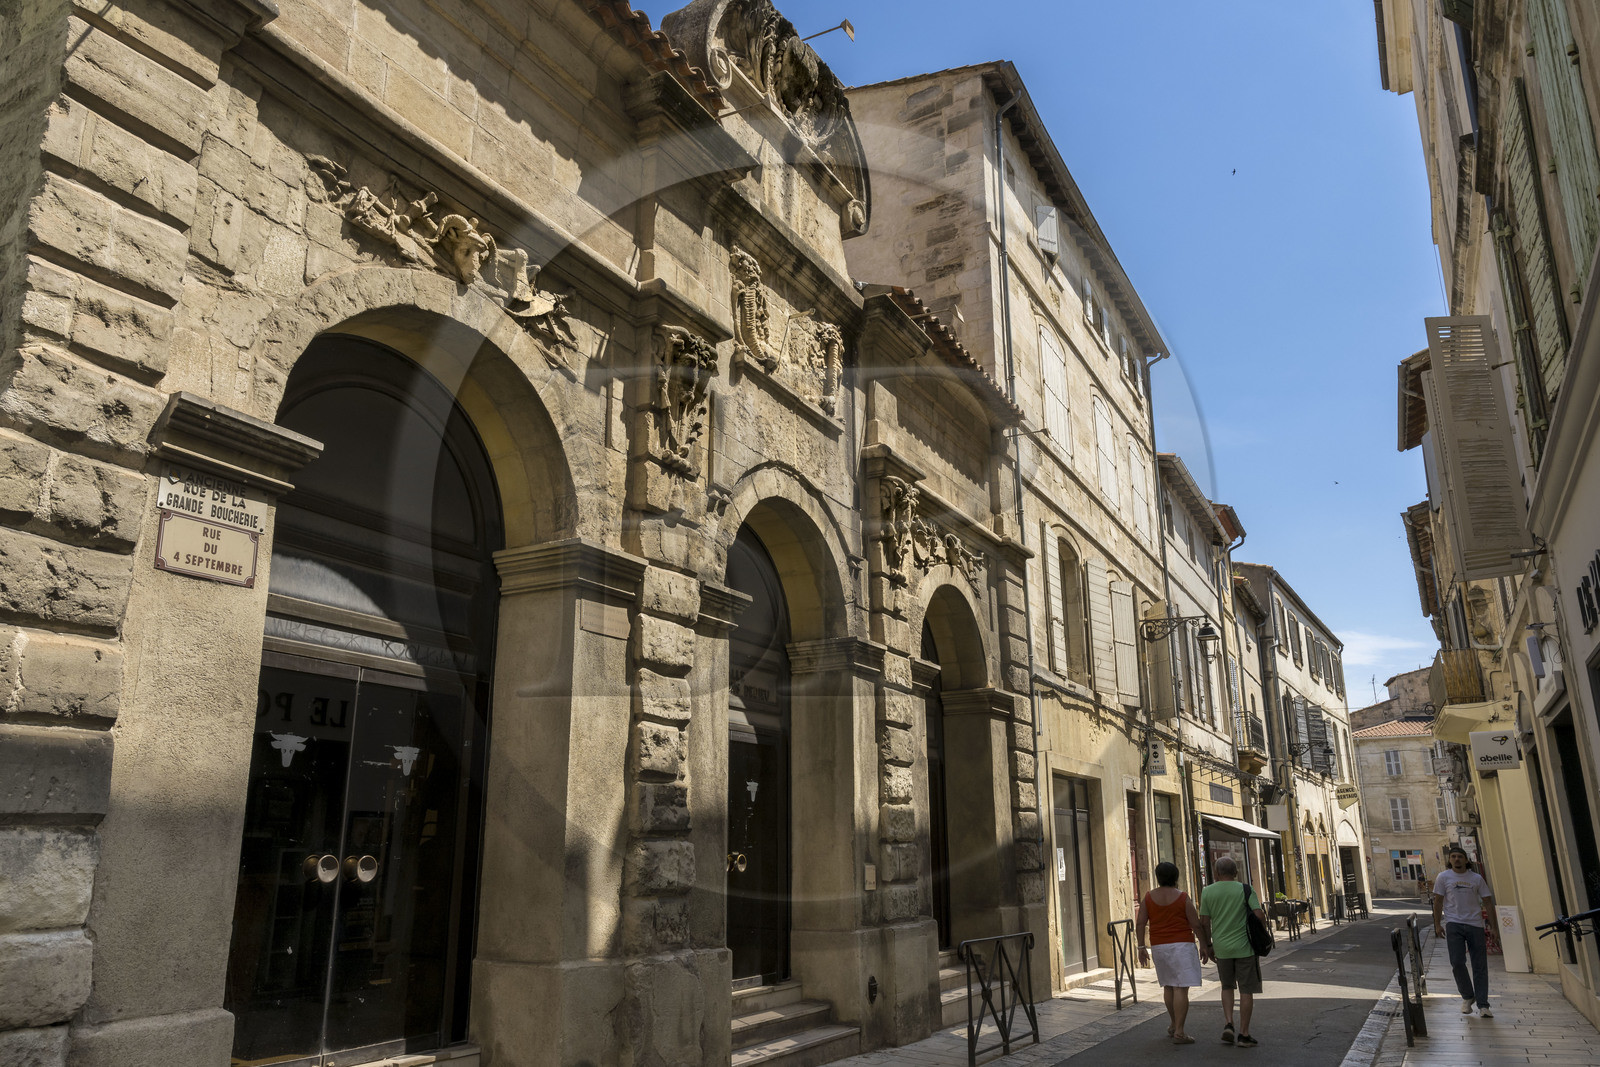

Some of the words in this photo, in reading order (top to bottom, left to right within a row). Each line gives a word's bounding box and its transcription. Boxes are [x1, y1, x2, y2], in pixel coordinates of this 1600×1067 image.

[184, 482, 206, 498] RUE
[212, 490, 227, 504] DE
[232, 496, 246, 509] LA
[186, 472, 246, 497] ANCIENNE
[166, 492, 203, 514] GRANDE
[211, 504, 258, 529] BOUCHERIE
[202, 527, 221, 540] RUE
[204, 542, 218, 555] DU
[173, 552, 180, 562] 4
[185, 554, 243, 576] SEPTEMBRE
[1480, 754, 1512, 762] abeille
